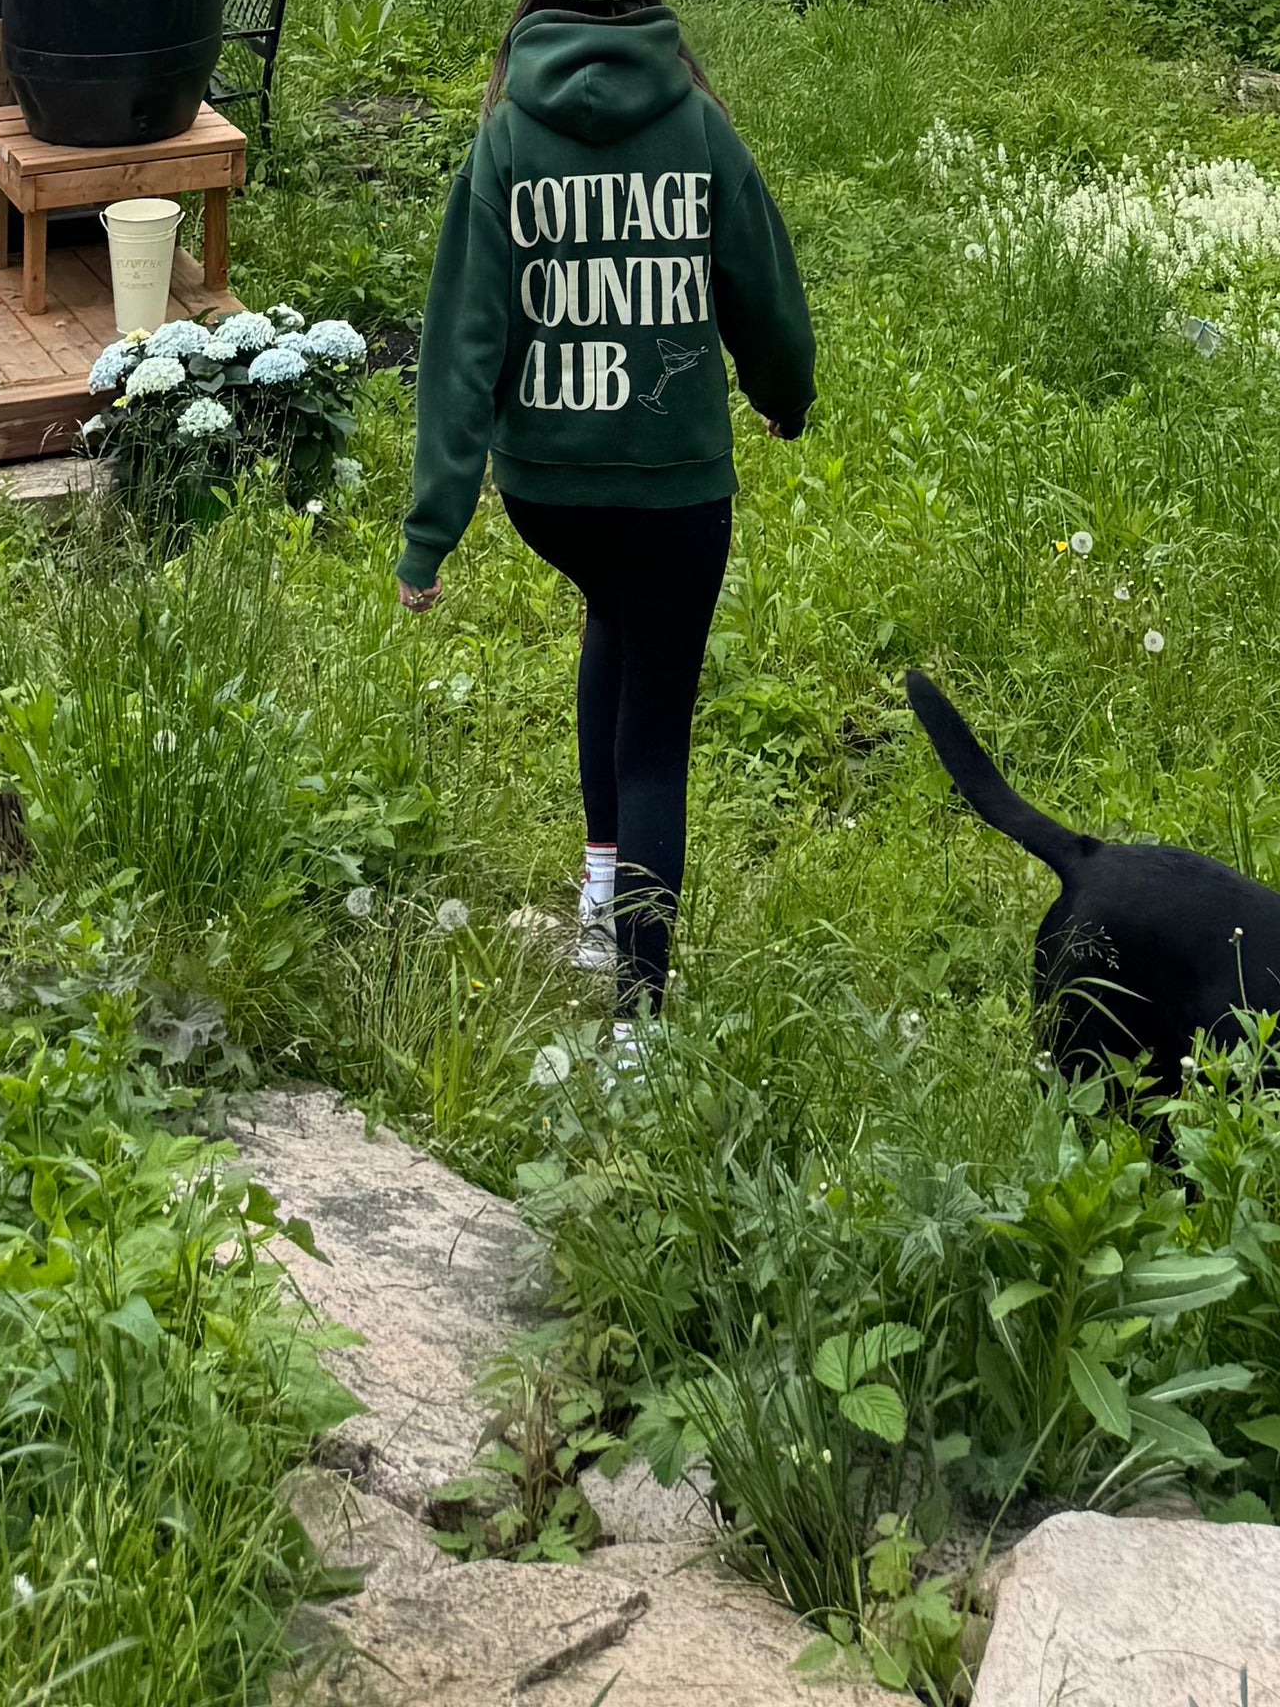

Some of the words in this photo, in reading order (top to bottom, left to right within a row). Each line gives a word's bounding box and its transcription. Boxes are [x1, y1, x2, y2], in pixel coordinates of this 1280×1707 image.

[510, 172, 712, 248] COTTAGE
[521, 254, 711, 328] COUNTRY
[519, 340, 630, 411] CLUB
